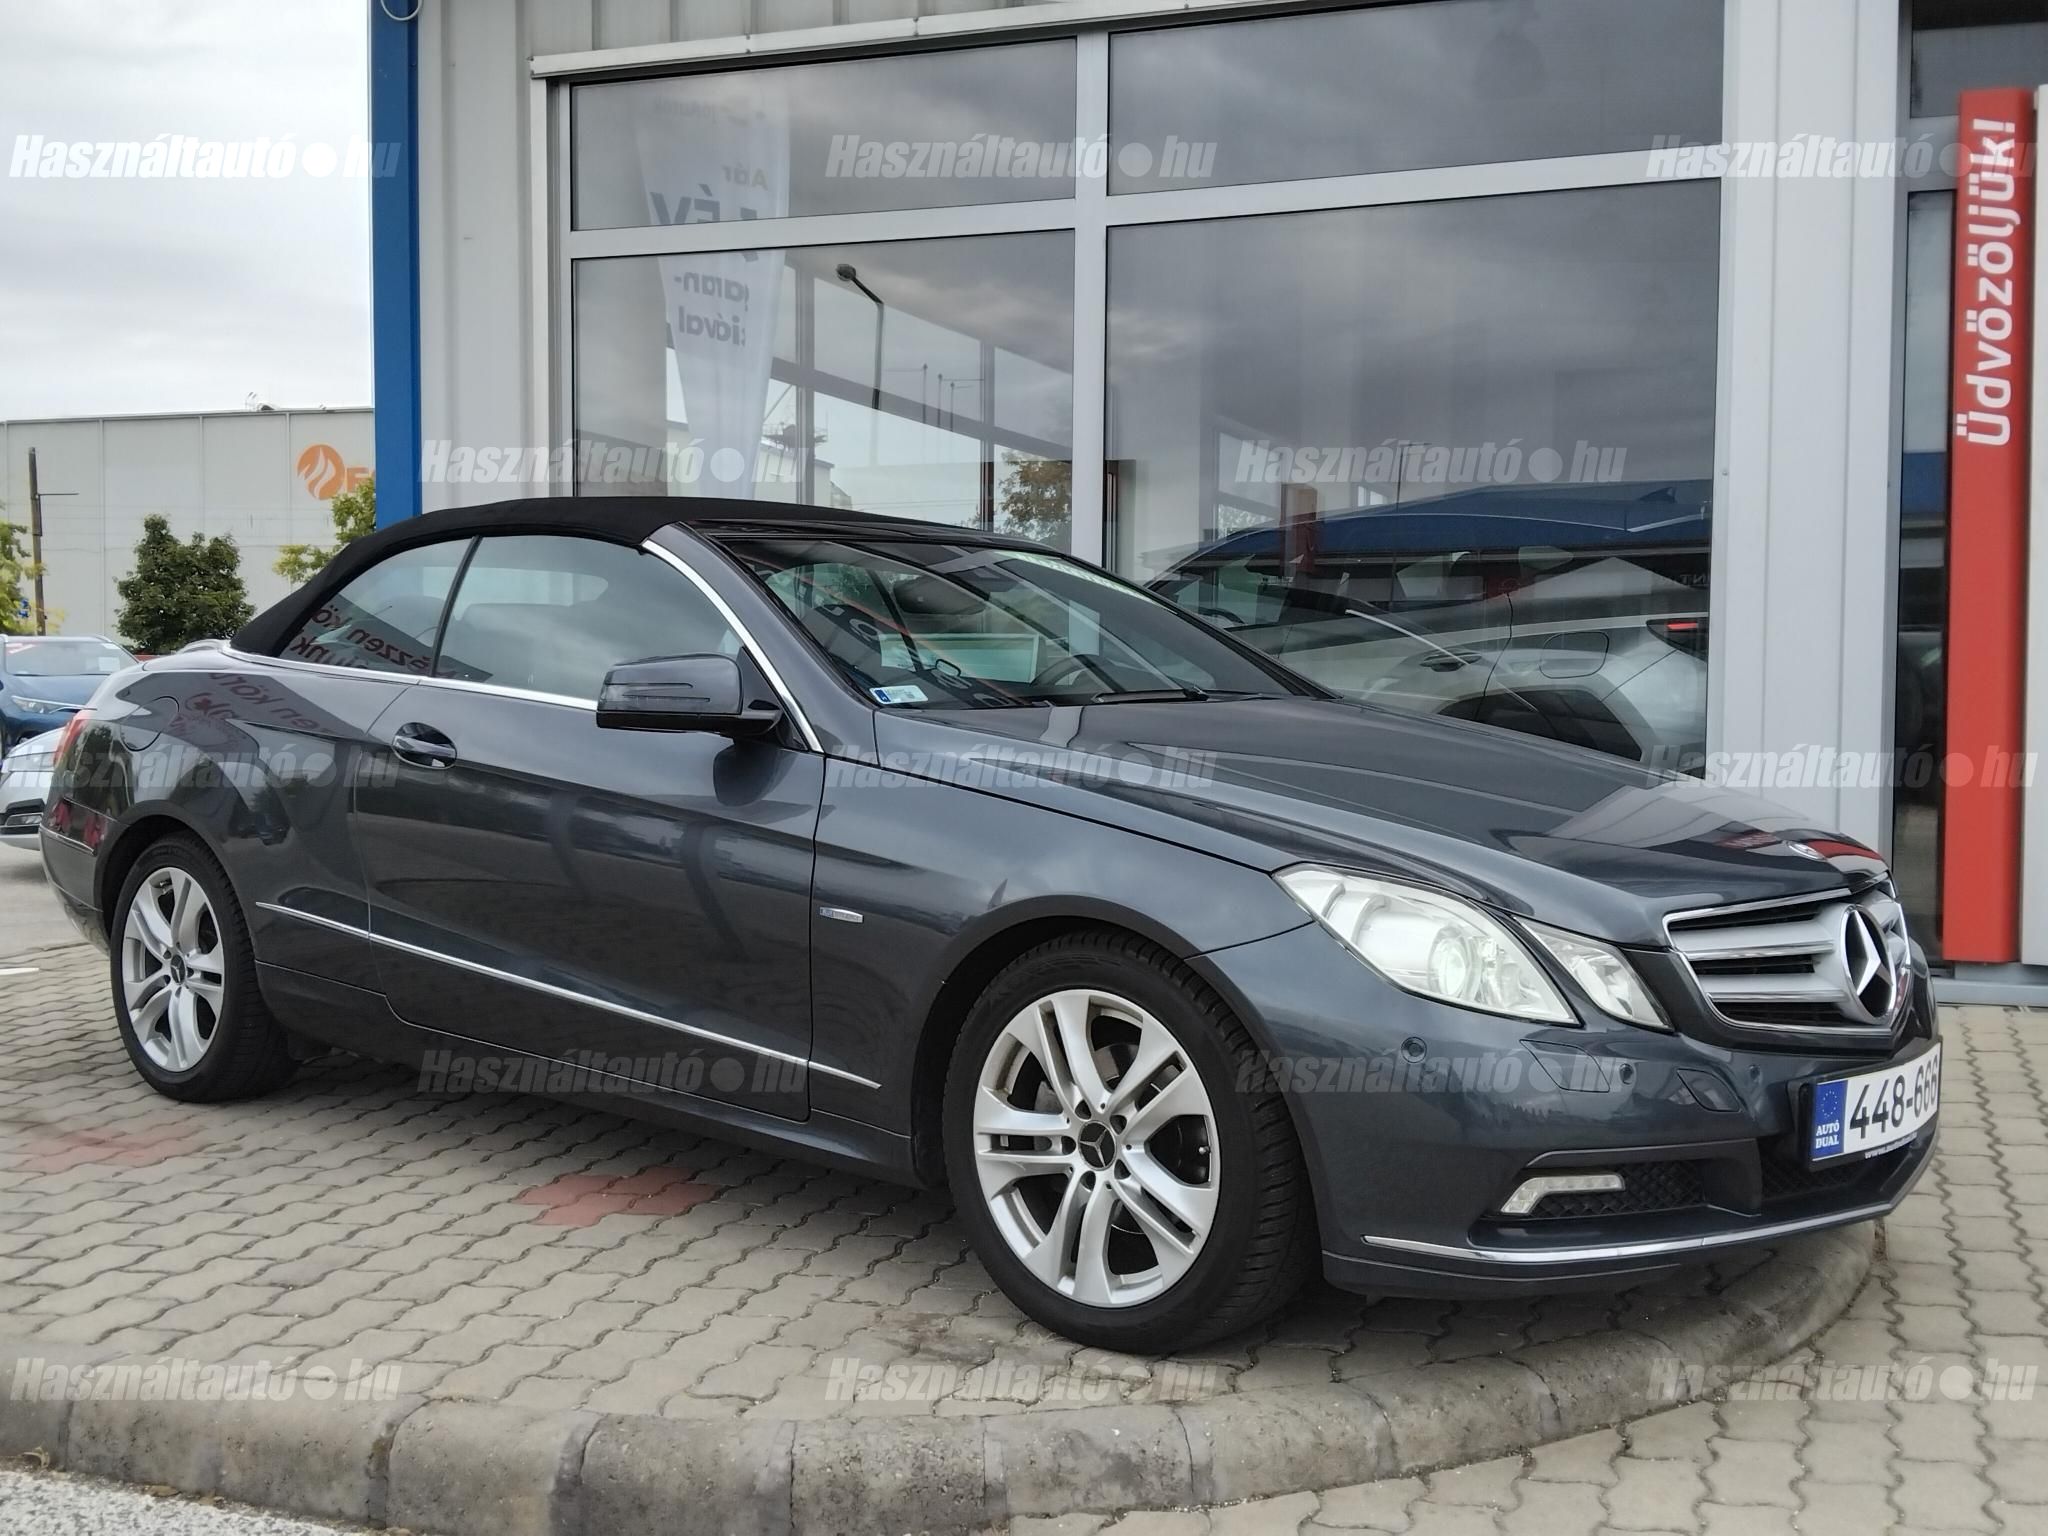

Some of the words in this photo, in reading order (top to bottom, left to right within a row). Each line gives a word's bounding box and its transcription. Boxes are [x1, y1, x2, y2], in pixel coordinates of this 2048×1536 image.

[1956, 117, 2021, 446] Üdvözöljük!
[1849, 1053, 1938, 1139] 448-666
[1815, 1120, 1840, 1136] AUTÓ
[1815, 1135, 1840, 1149] DUAL
